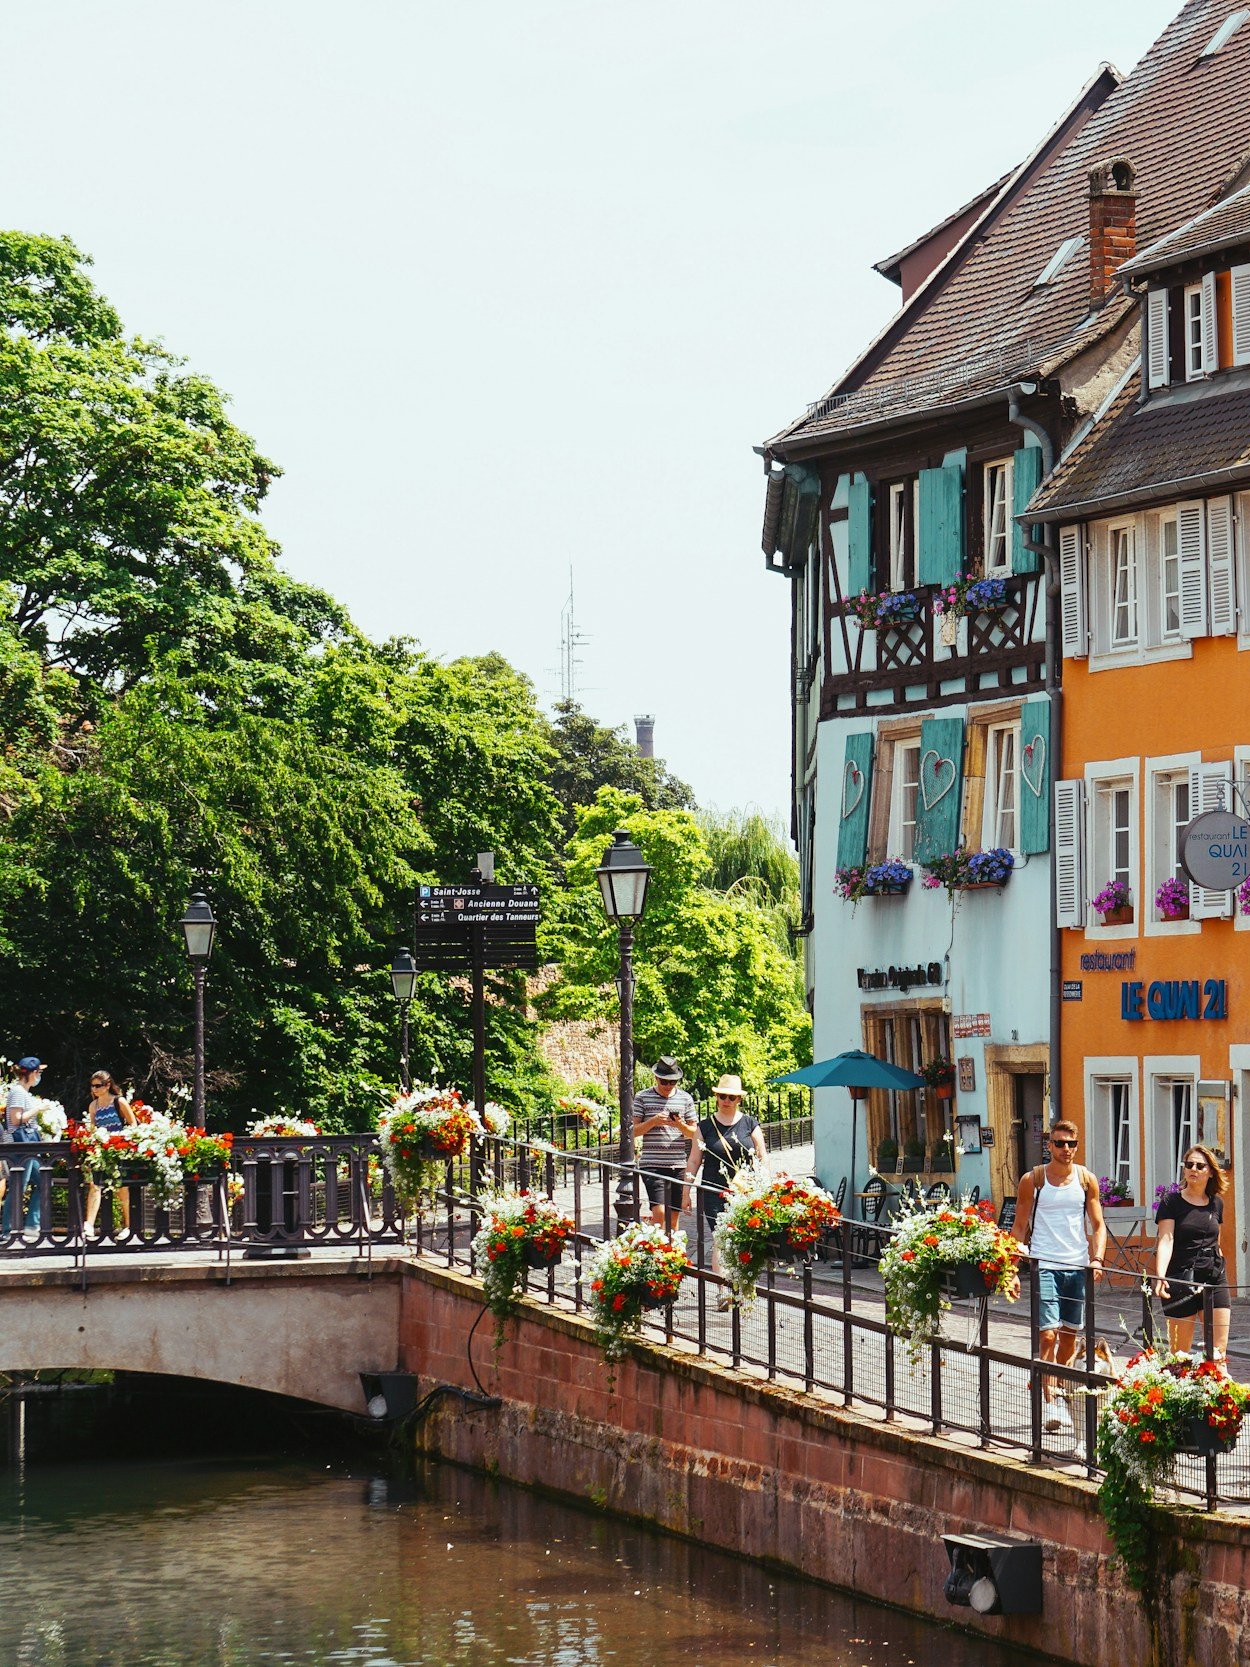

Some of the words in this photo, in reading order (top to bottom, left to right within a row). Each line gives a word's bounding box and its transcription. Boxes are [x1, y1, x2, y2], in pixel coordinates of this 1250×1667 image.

[1189, 833, 1230, 841] restaurant
[1232, 826, 1247, 839] LE
[1208, 844, 1247, 858] QUAI
[1232, 862, 1247, 876] 21
[433, 887, 481, 896] Saint-Josse
[467, 900, 505, 908] Ancienne
[508, 899, 538, 908] Douane
[458, 913, 489, 921] Quartier
[490, 912, 504, 921] des
[506, 912, 539, 921] Tanneurs
[1080, 948, 1136, 972] restaurant
[1121, 981, 1144, 1020] LE
[1147, 980, 1201, 1020] QUAI
[1203, 979, 1228, 1020] 21
